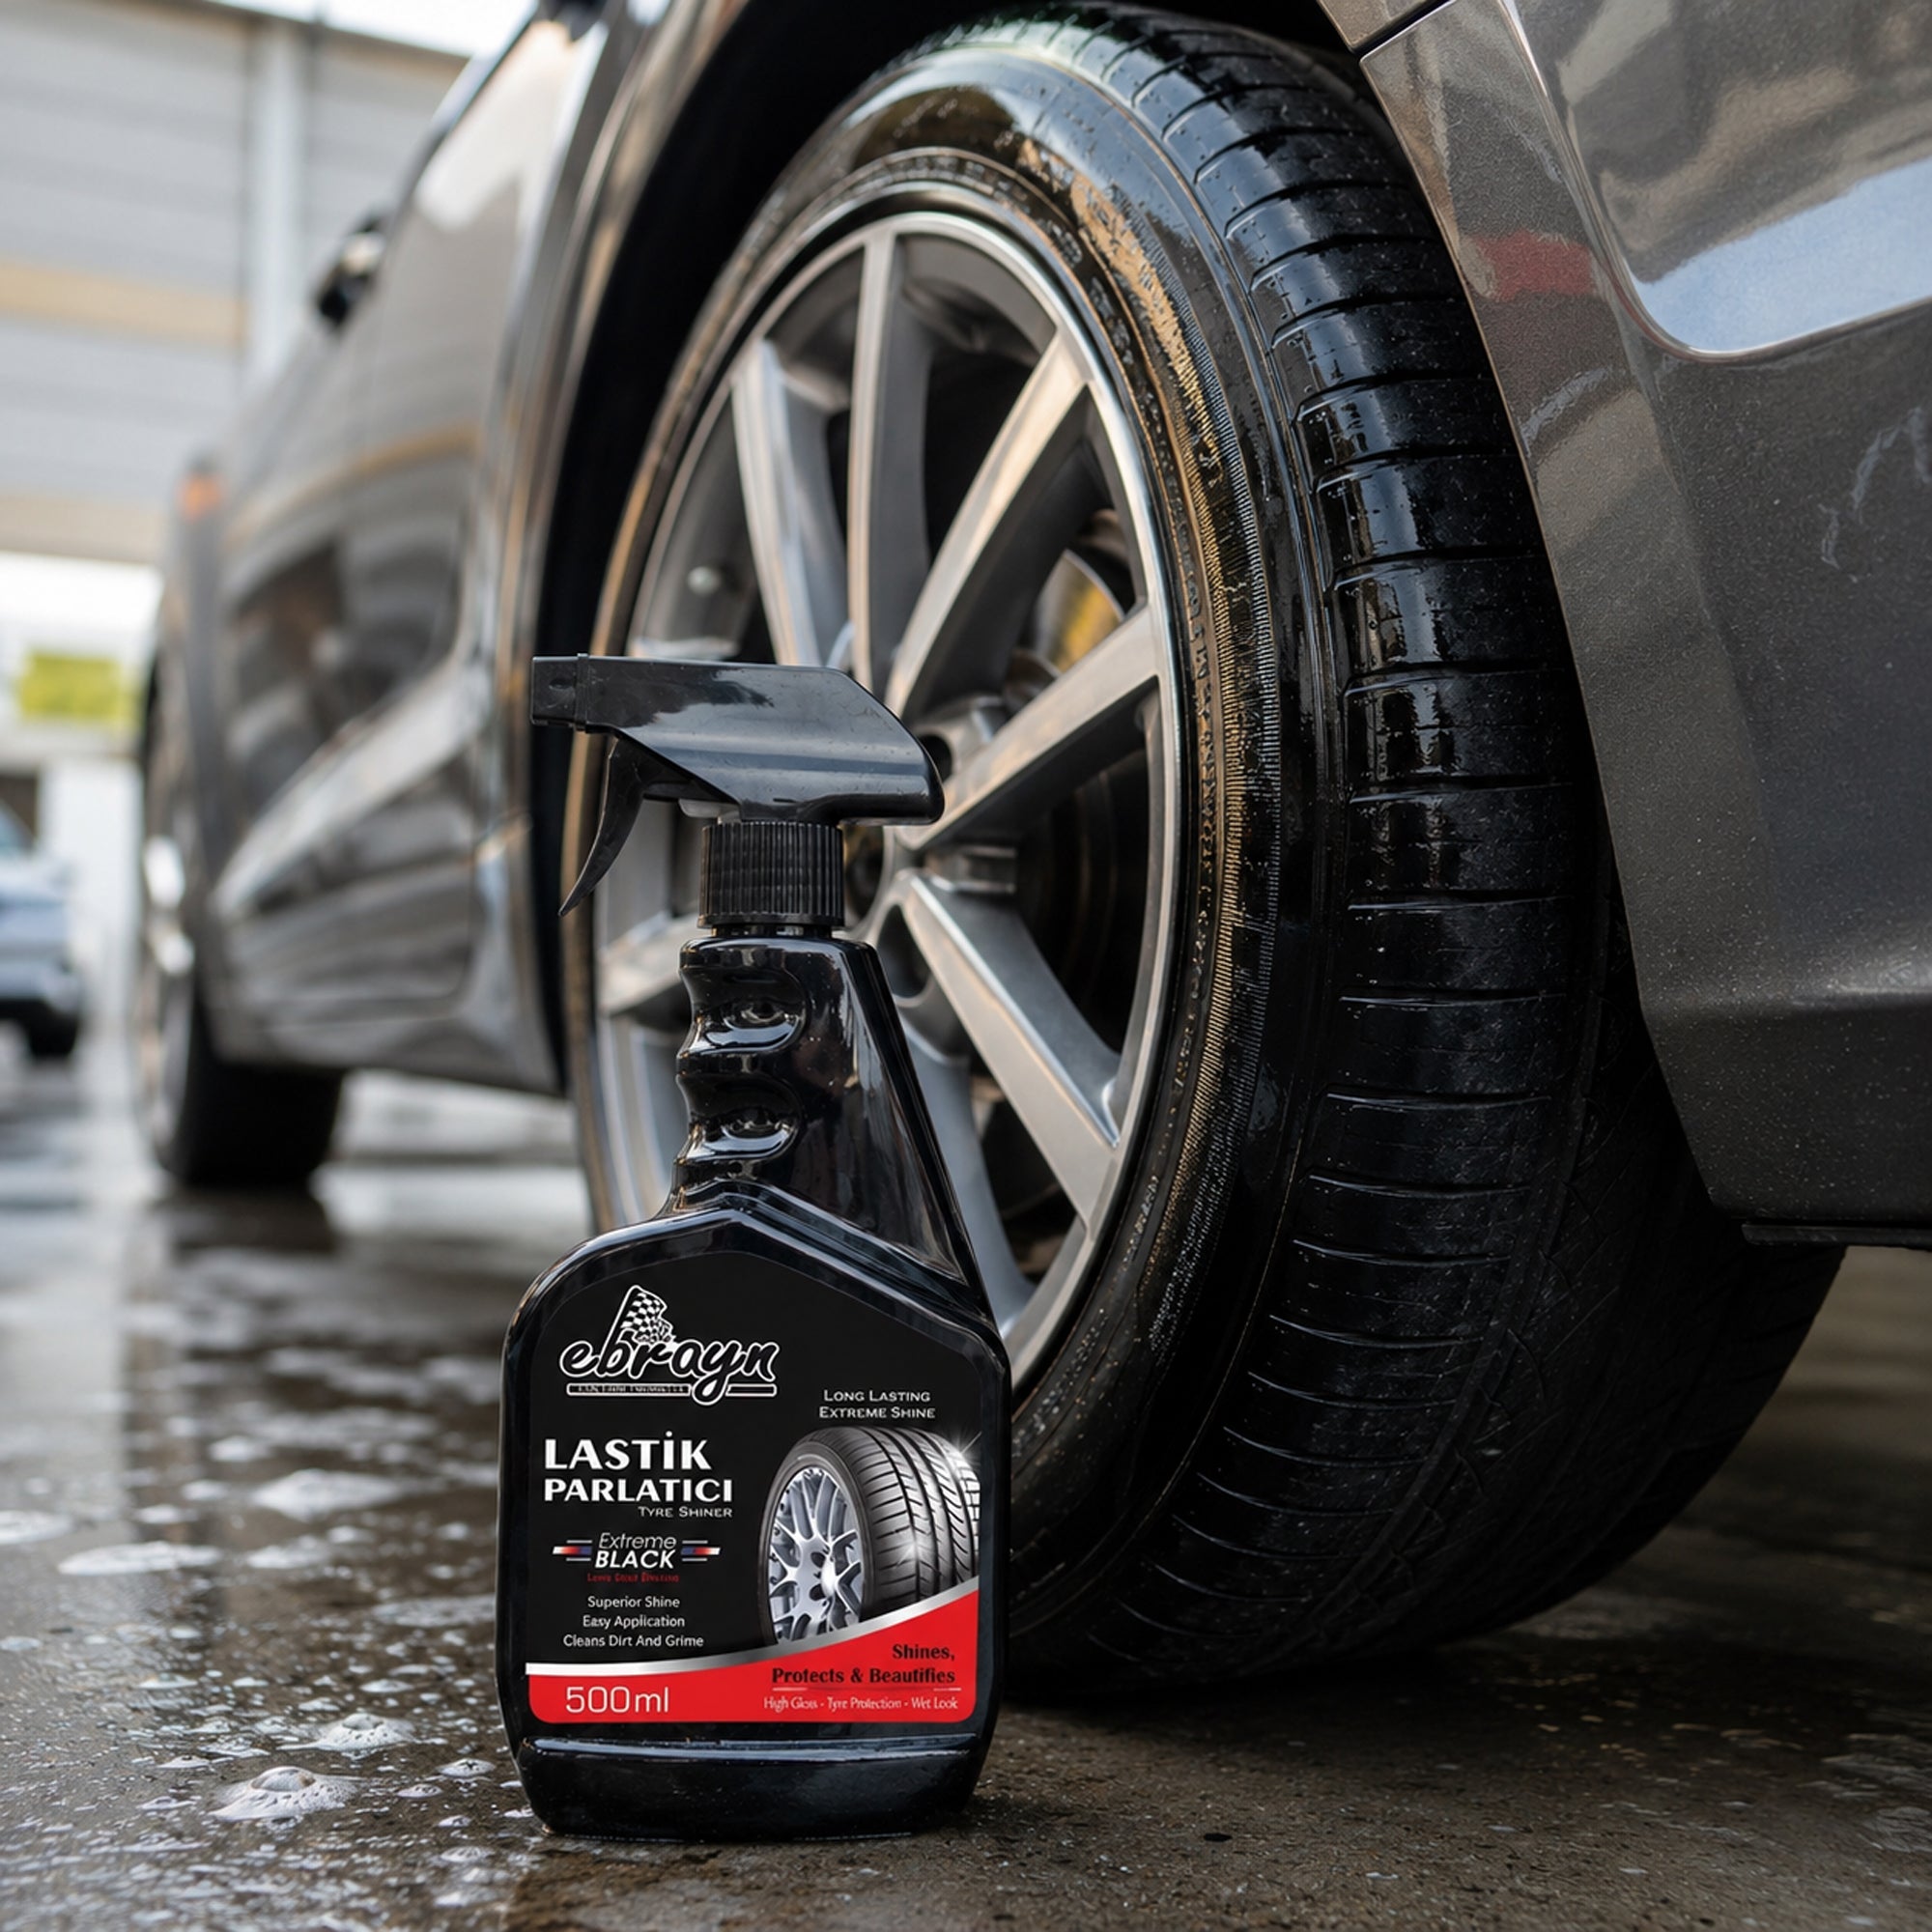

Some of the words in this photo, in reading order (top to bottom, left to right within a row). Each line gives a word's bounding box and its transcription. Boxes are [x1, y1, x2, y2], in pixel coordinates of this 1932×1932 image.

[544, 1478, 733, 1503] PARLATICI
[598, 1532, 676, 1549] Extreme
[594, 1549, 676, 1569] BLACK
[587, 1596, 641, 1609] Superior
[644, 1596, 680, 1608] Shine
[582, 1614, 611, 1630] Easy
[613, 1614, 685, 1630] Application
[563, 1634, 606, 1647] Cleans
[609, 1635, 633, 1647] Dirt
[635, 1635, 662, 1647] And
[665, 1634, 704, 1647] Grime
[892, 1643, 955, 1661] Shines,
[773, 1668, 844, 1683] Protects
[850, 1668, 863, 1683] &
[869, 1667, 955, 1683] Beautifies
[565, 1686, 669, 1714] 500ml
[933, 1696, 958, 1709] Look
